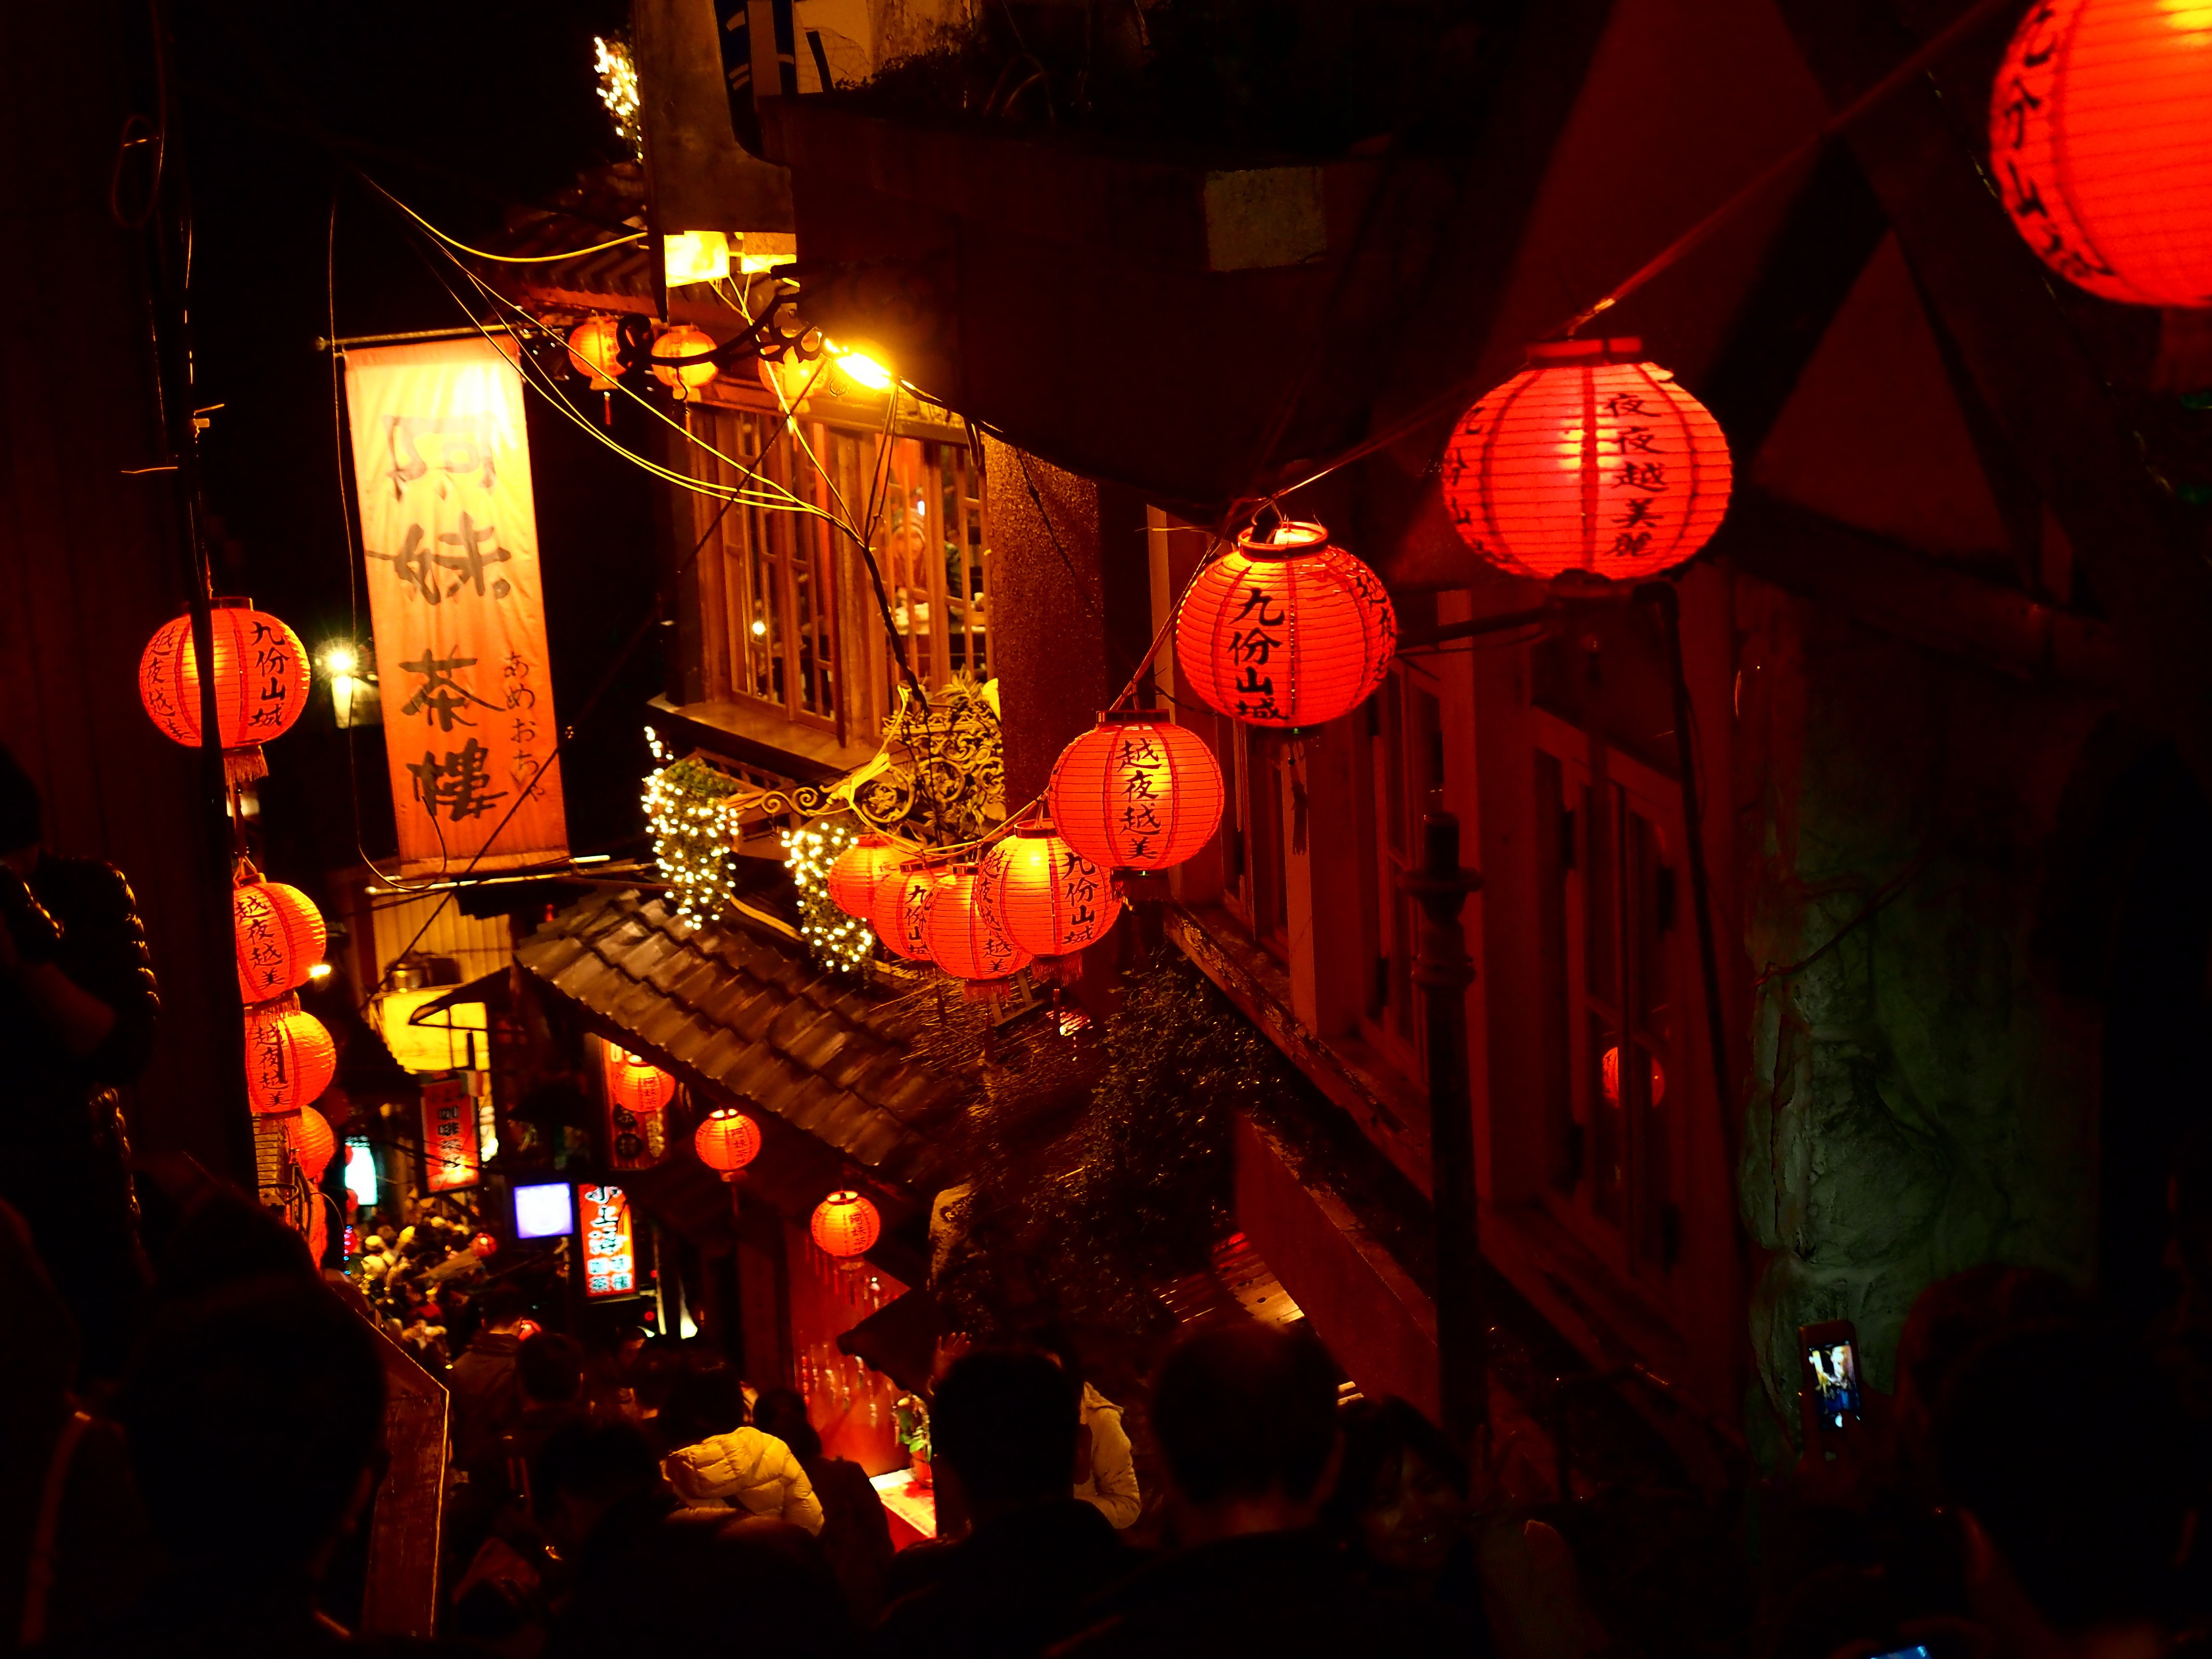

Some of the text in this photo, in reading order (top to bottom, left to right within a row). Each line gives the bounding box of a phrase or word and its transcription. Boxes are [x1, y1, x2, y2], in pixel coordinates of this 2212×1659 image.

[146, 625, 196, 740] 越夜越美
[248, 621, 290, 727] 九份山城
[1227, 587, 1290, 720] 九份山城
[1116, 737, 1162, 860] 越夜越美
[234, 895, 286, 991] 越夜越美
[982, 927, 1012, 975] 越美
[1061, 852, 1099, 944] 九份山城
